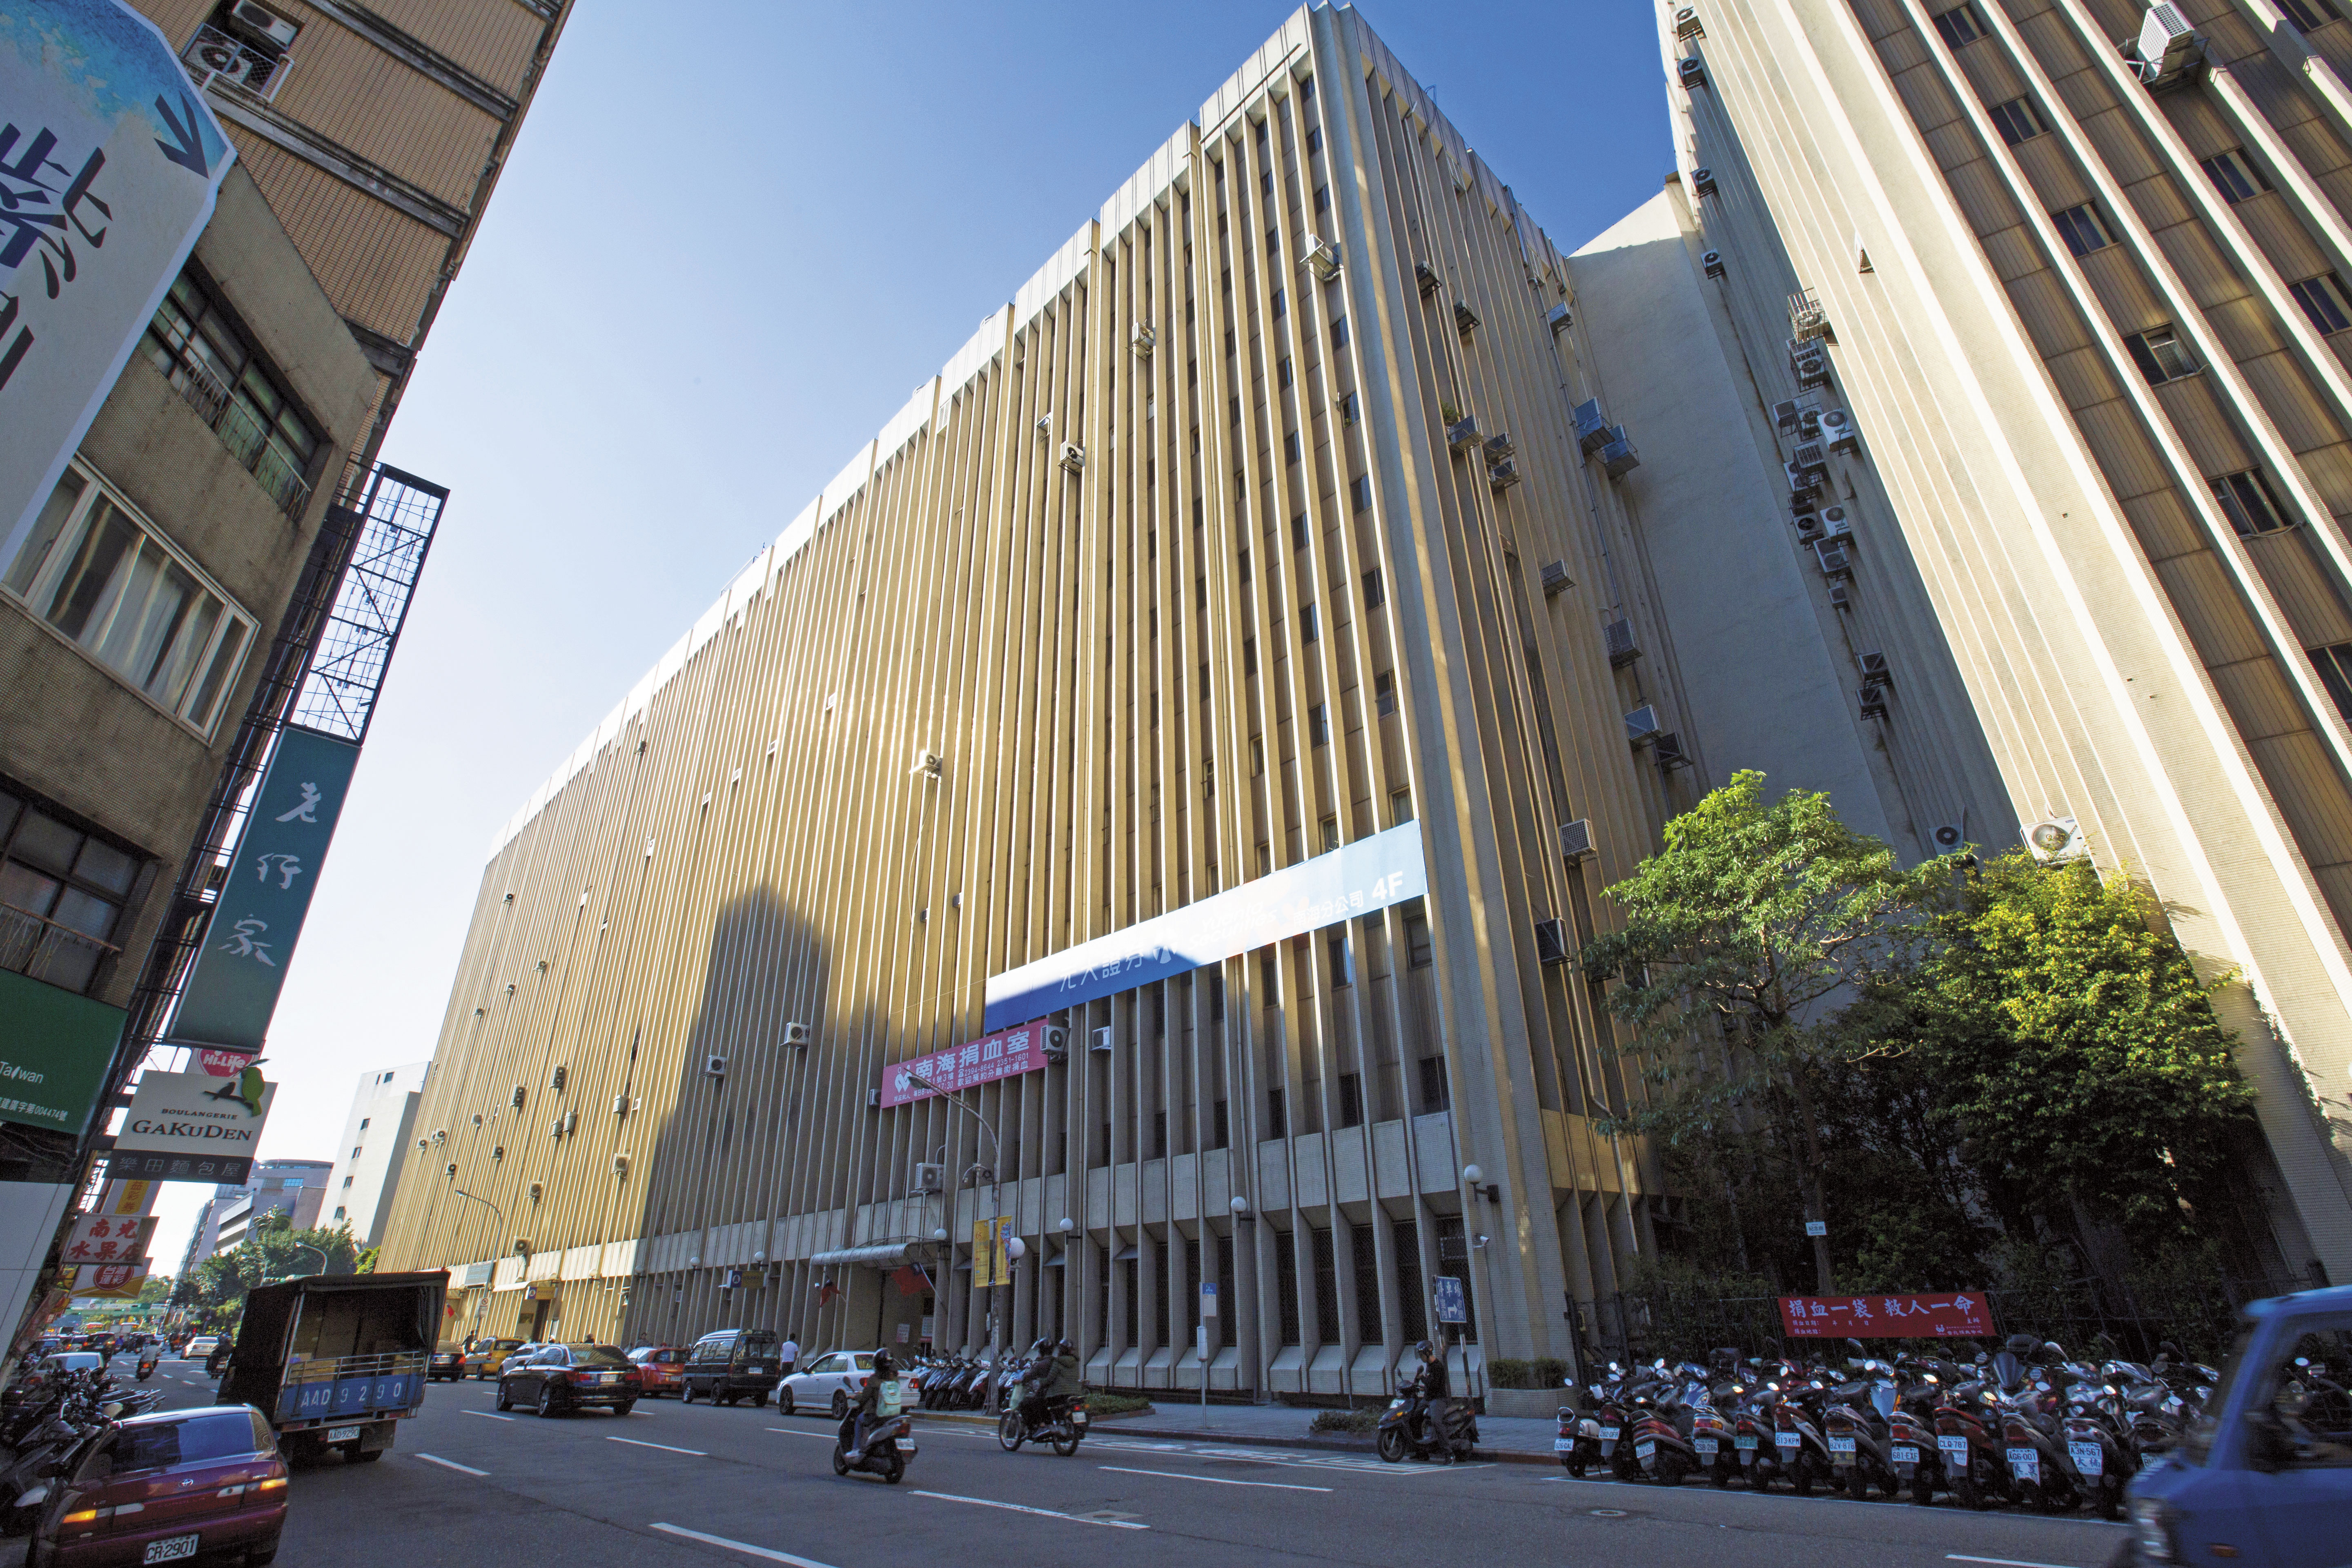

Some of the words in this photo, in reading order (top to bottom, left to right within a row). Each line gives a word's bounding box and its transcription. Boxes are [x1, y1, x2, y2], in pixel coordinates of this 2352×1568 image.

[1372, 871, 1403, 900] 4F
[1202, 901, 1264, 933] Yuanta
[1293, 889, 1363, 927] 南海分公司
[1188, 909, 1277, 950] Securities
[203, 1051, 246, 1073] Hi-Life
[915, 1031, 1030, 1079] 南海捐血室
[964, 1062, 994, 1076] 2394-8644
[997, 1053, 1029, 1067] 2351-1601
[162, 1108, 238, 1120] BOULANGERIE
[131, 1120, 253, 1140] GAKUDEN
[117, 1157, 241, 1177] 樂田麵包屋
[1437, 1281, 1461, 1297] 停車場
[1788, 1298, 1873, 1318] 捐血一袋
[1884, 1295, 1974, 1316] 救人一命
[329, 1428, 359, 1439] AAD-9290
[2071, 1447, 2100, 1456] A3N-567
[146, 1539, 195, 1561] CR-2901
